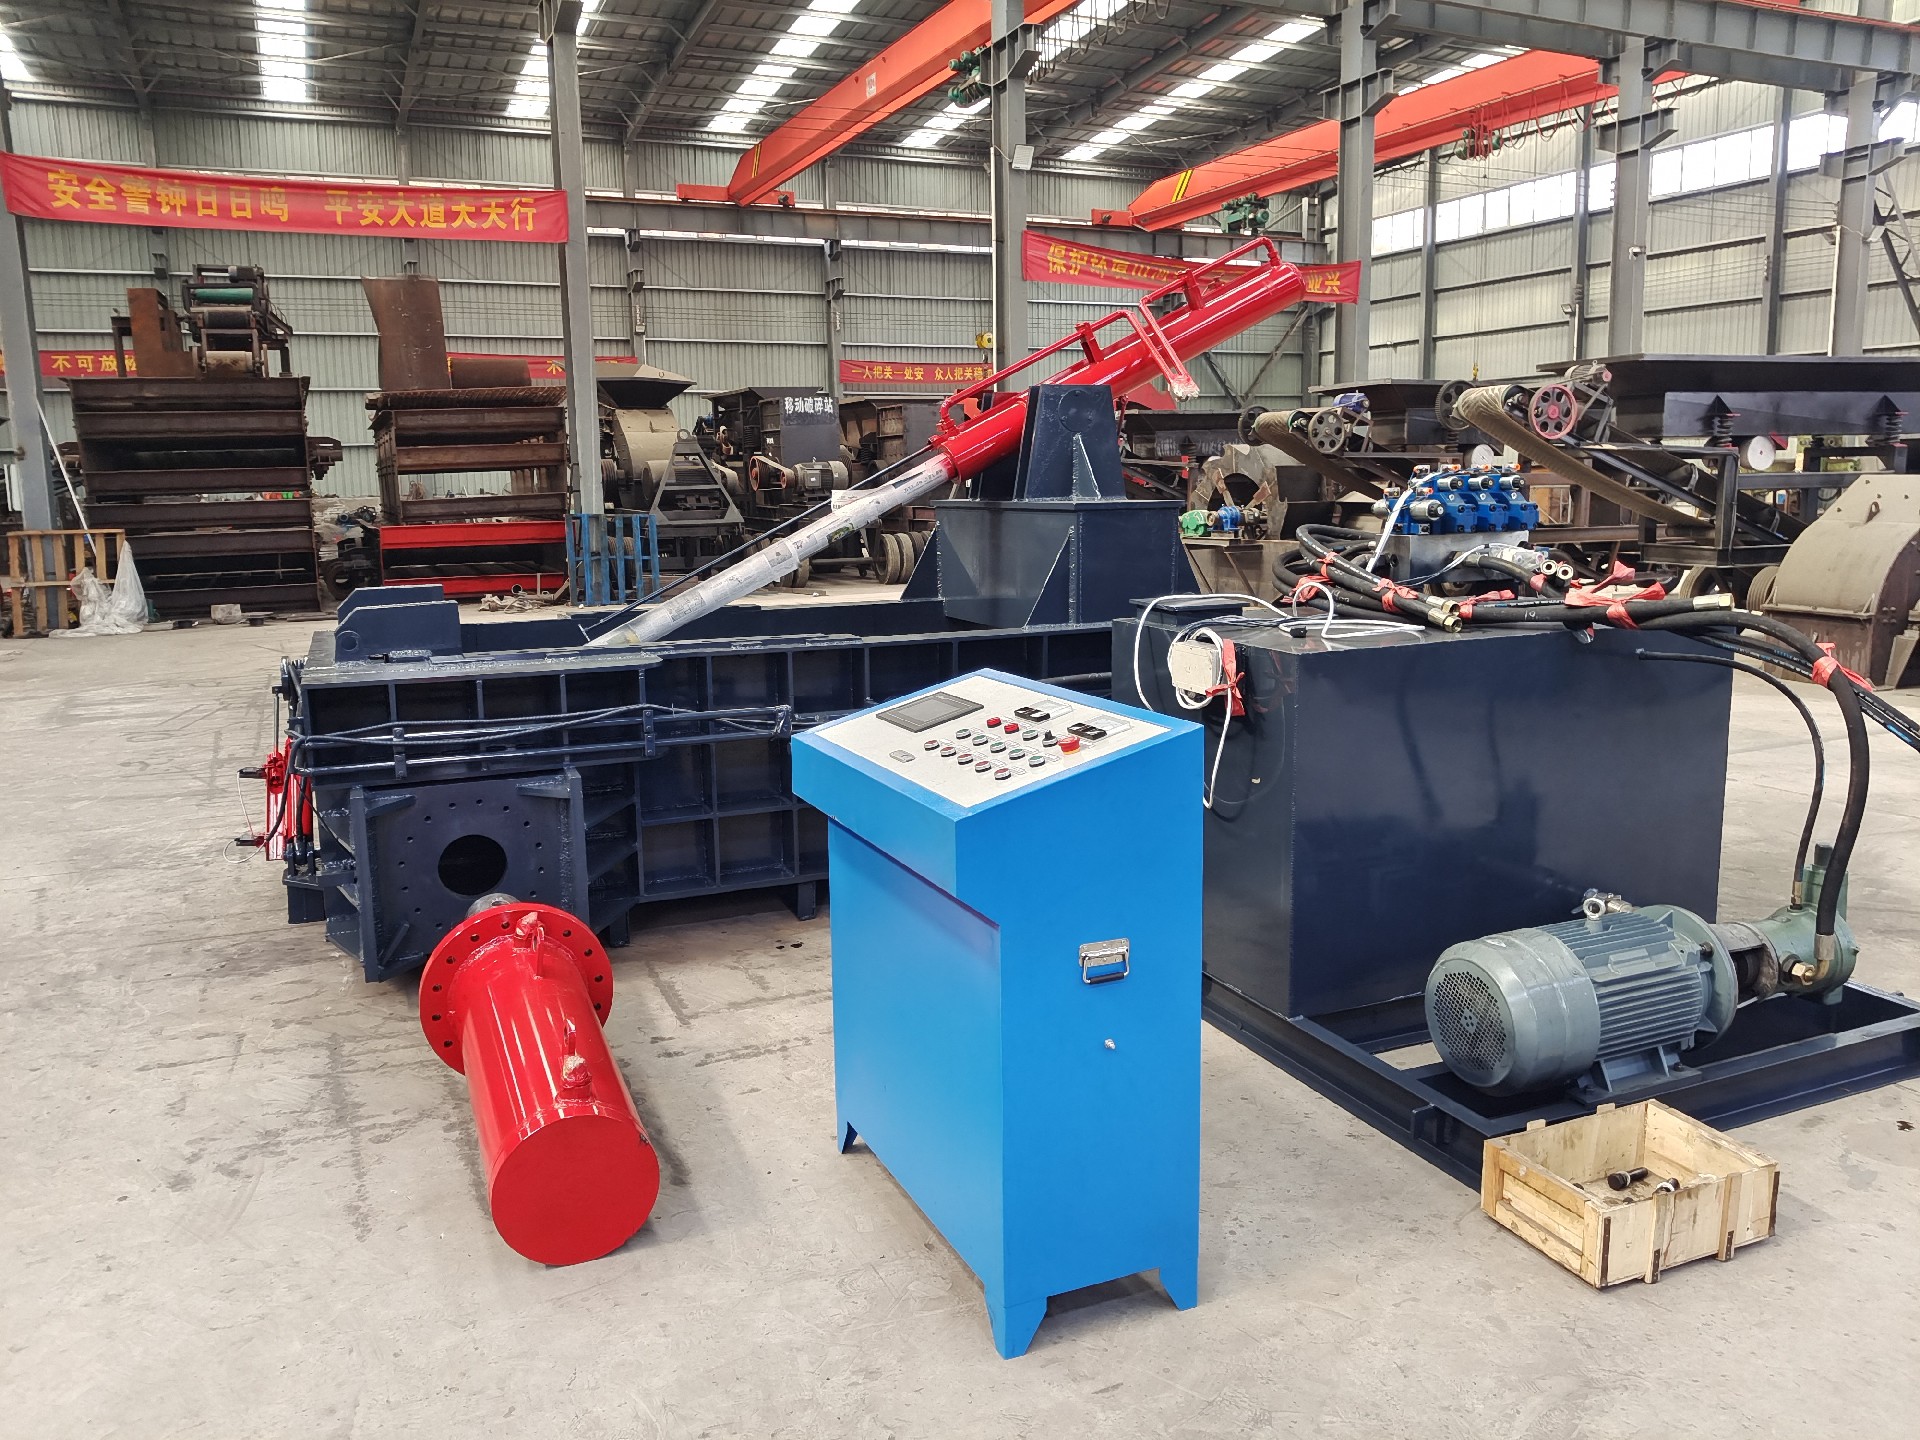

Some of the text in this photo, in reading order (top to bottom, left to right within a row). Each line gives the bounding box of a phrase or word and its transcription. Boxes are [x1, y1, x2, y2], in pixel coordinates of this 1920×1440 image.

[47, 169, 538, 232] 安全警钟日日鸣 平安大道天天行
[851, 365, 924, 381] 一人把关一处安
[784, 396, 834, 415] 移动破碎站
